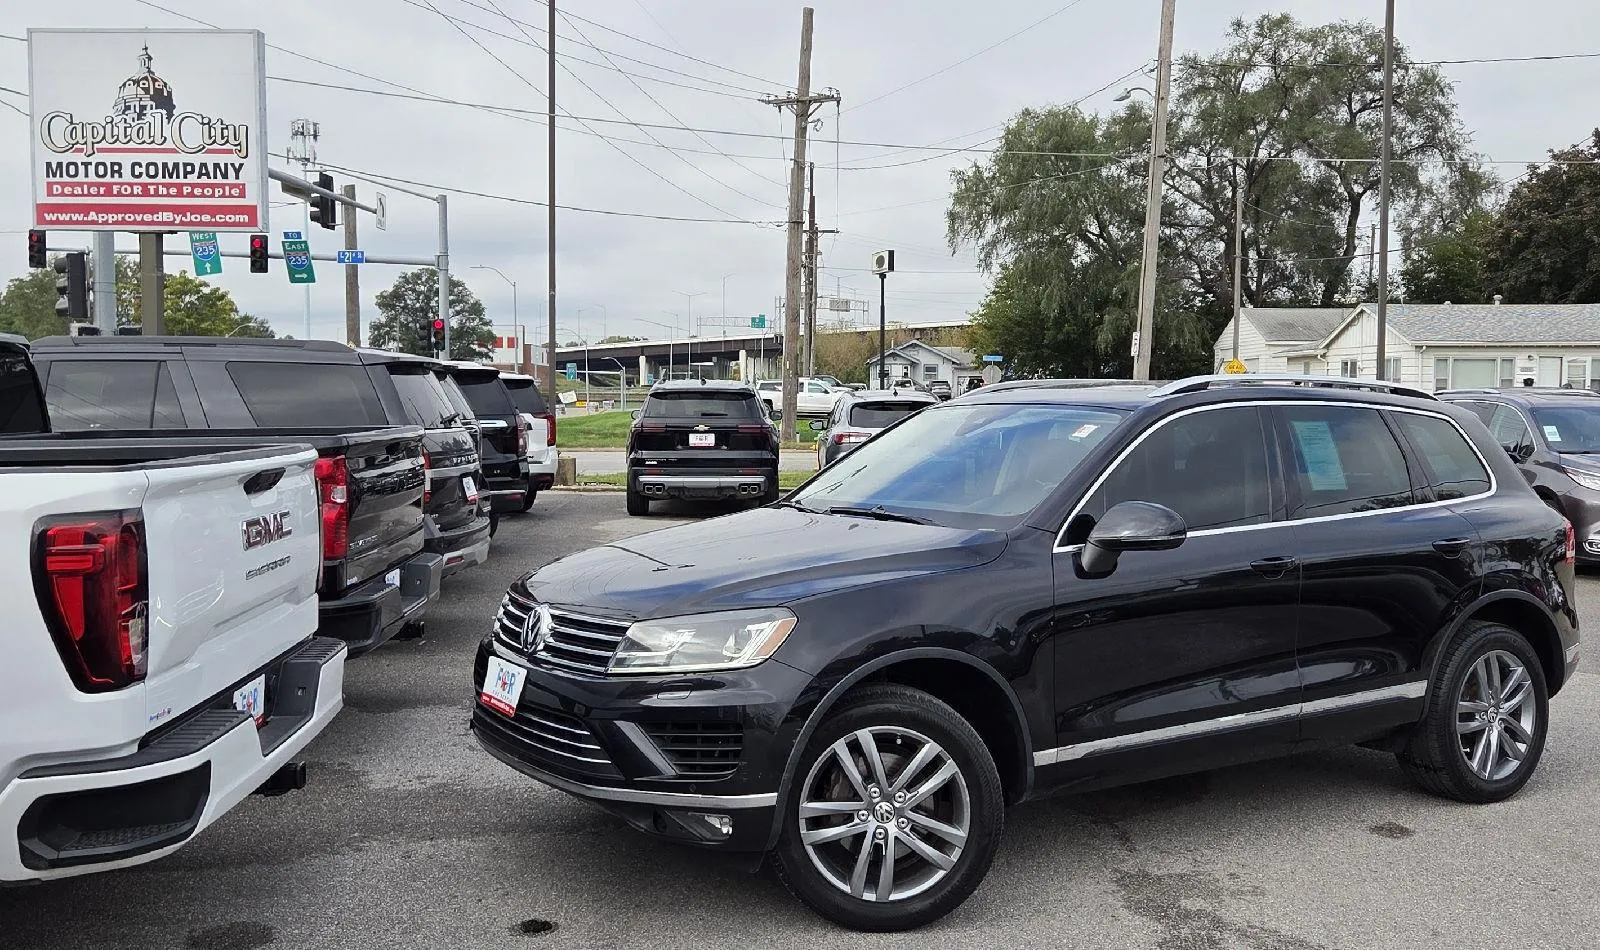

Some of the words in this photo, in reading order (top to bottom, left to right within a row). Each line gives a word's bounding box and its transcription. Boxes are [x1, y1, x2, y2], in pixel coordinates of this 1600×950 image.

[40, 110, 166, 157] Capital
[171, 112, 249, 159] City
[45, 162, 123, 179] MOTOR
[130, 162, 245, 180] COMPANY
[52, 184, 106, 195] Dealer
[112, 185, 143, 195] FOR
[148, 185, 178, 195] The
[44, 211, 249, 223] www.ApprovedByJoe.com
[192, 232, 214, 241] WEST
[196, 245, 215, 256] 235
[289, 255, 308, 265] 235
[242, 510, 292, 551] GMC
